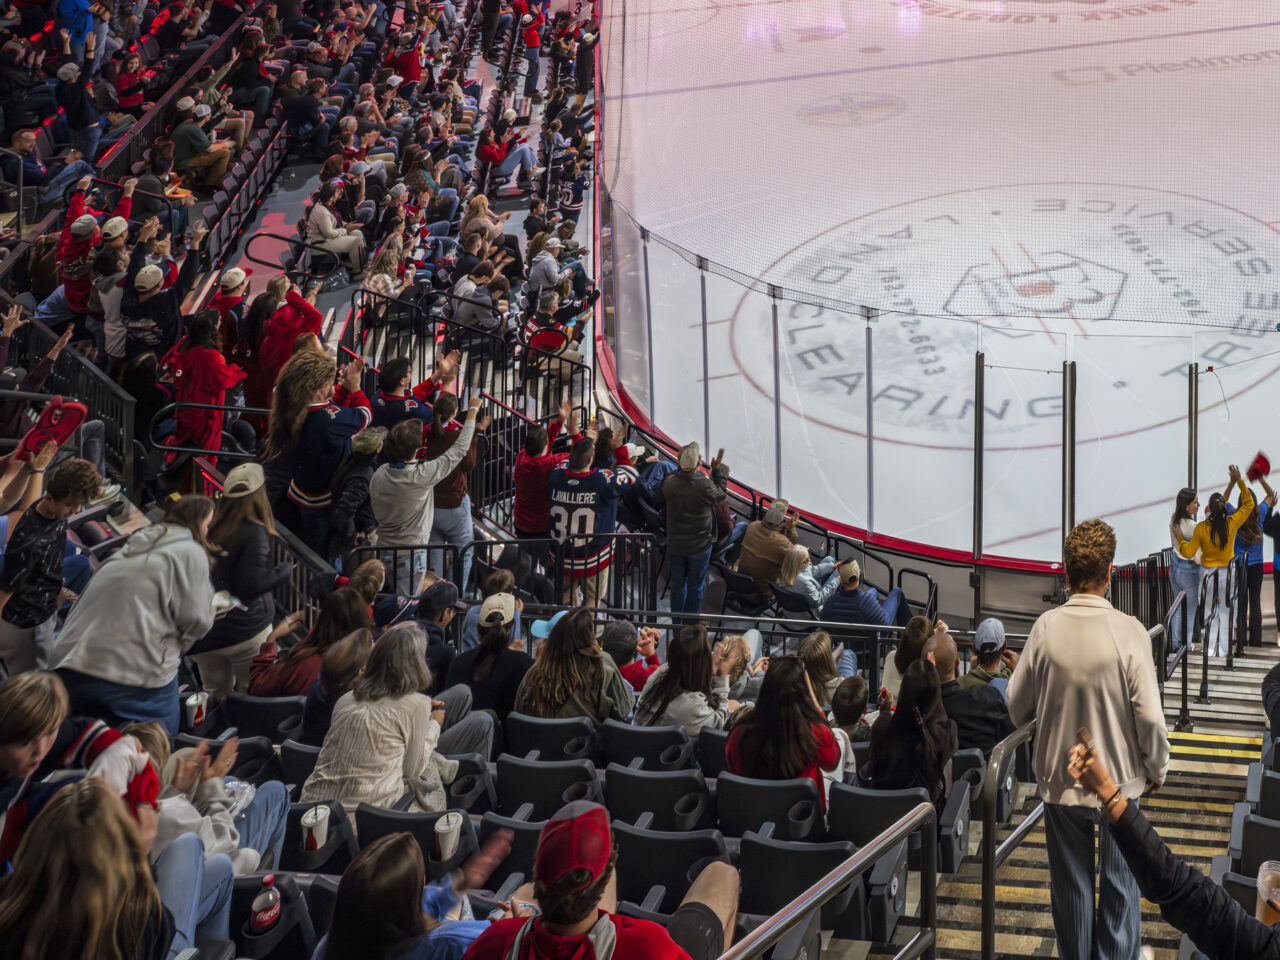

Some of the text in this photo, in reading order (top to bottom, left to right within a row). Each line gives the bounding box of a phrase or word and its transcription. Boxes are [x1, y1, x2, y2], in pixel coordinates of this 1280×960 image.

[1082, 3, 1171, 23] ROCK
[1034, 196, 1280, 384] TREE SERVICE
[788, 213, 1065, 422] LAND CLEARING
[551, 489, 597, 505] LAVALLIERE
[550, 505, 596, 548] 30
